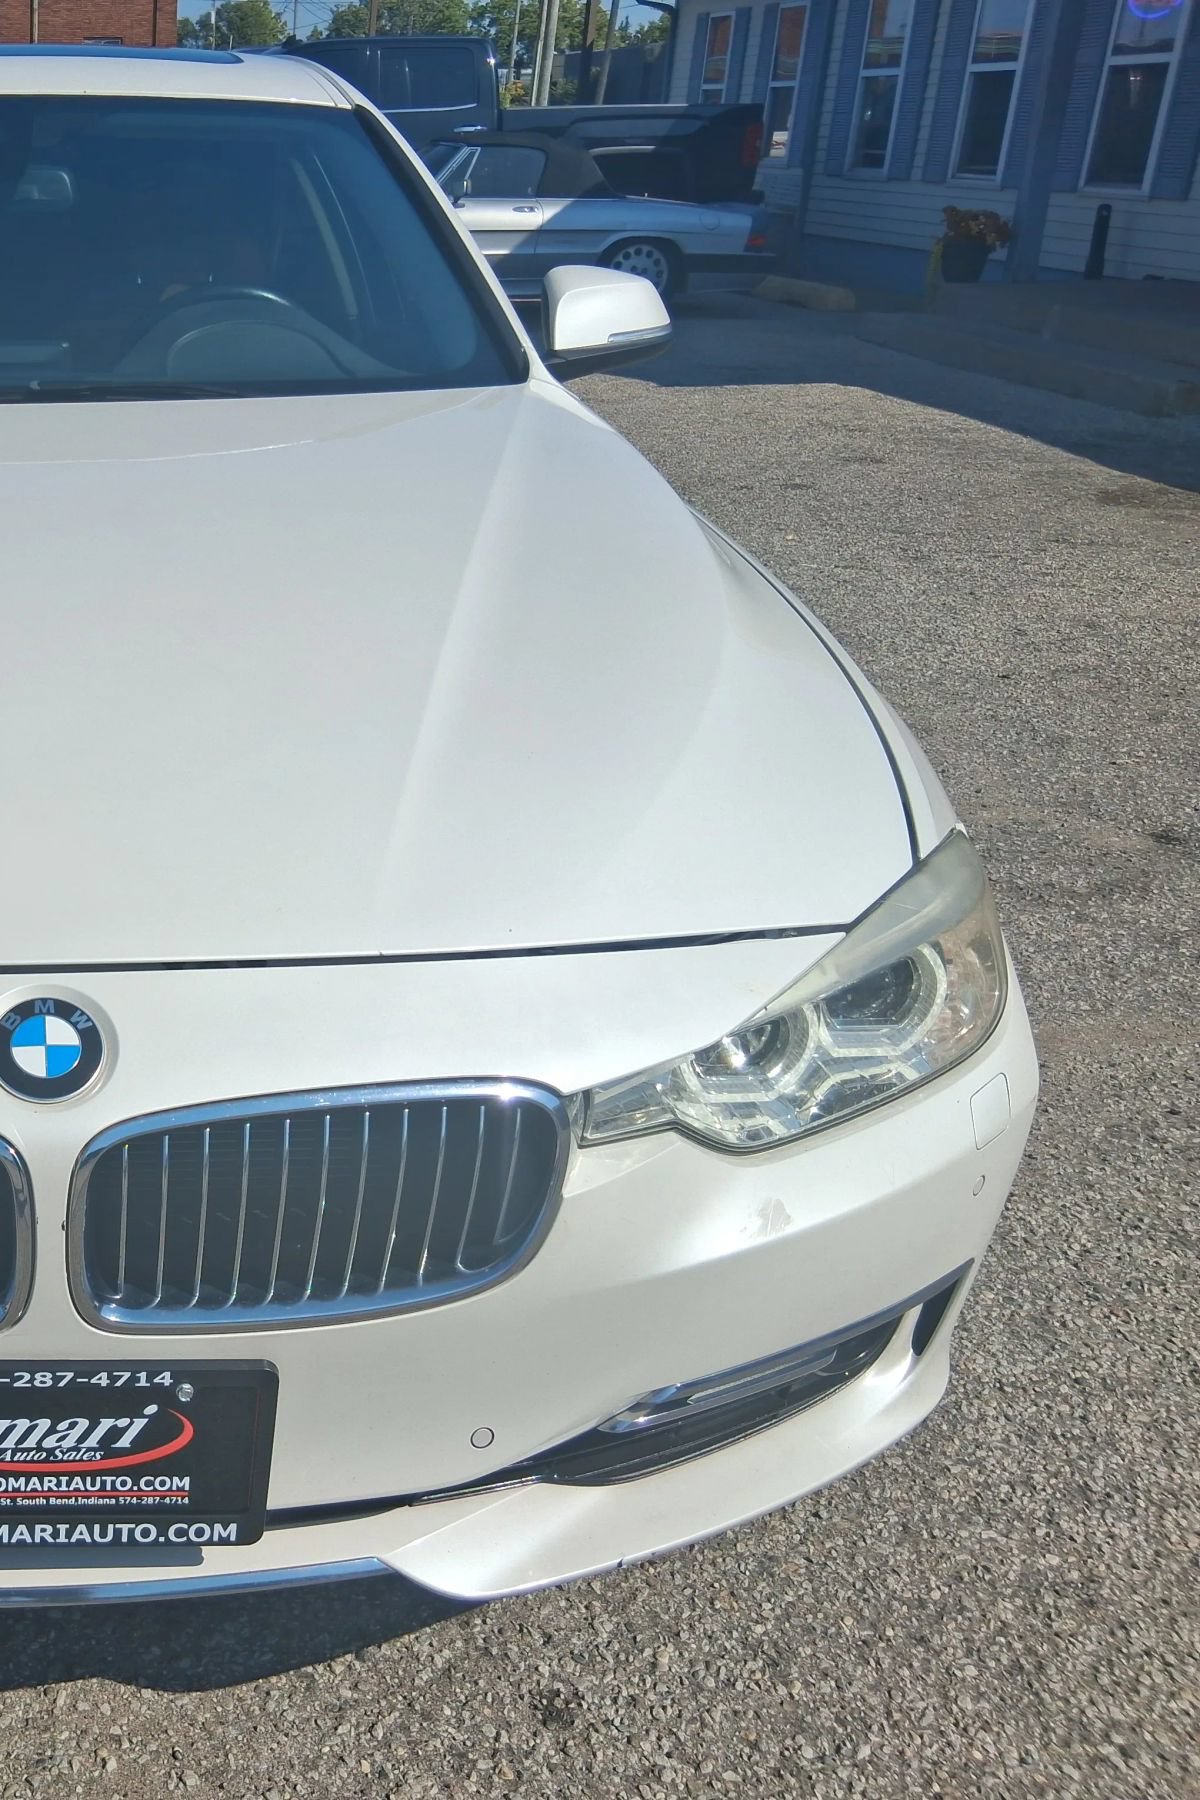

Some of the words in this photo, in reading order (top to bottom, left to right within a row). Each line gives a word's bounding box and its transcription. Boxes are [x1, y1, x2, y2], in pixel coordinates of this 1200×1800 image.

[0, 999, 93, 1031] BMW
[49, 1448, 104, 1461] Sales
[0, 1497, 14, 1506] St.
[16, 1496, 46, 1505] South
[118, 1496, 189, 1504] 574-287-4714
